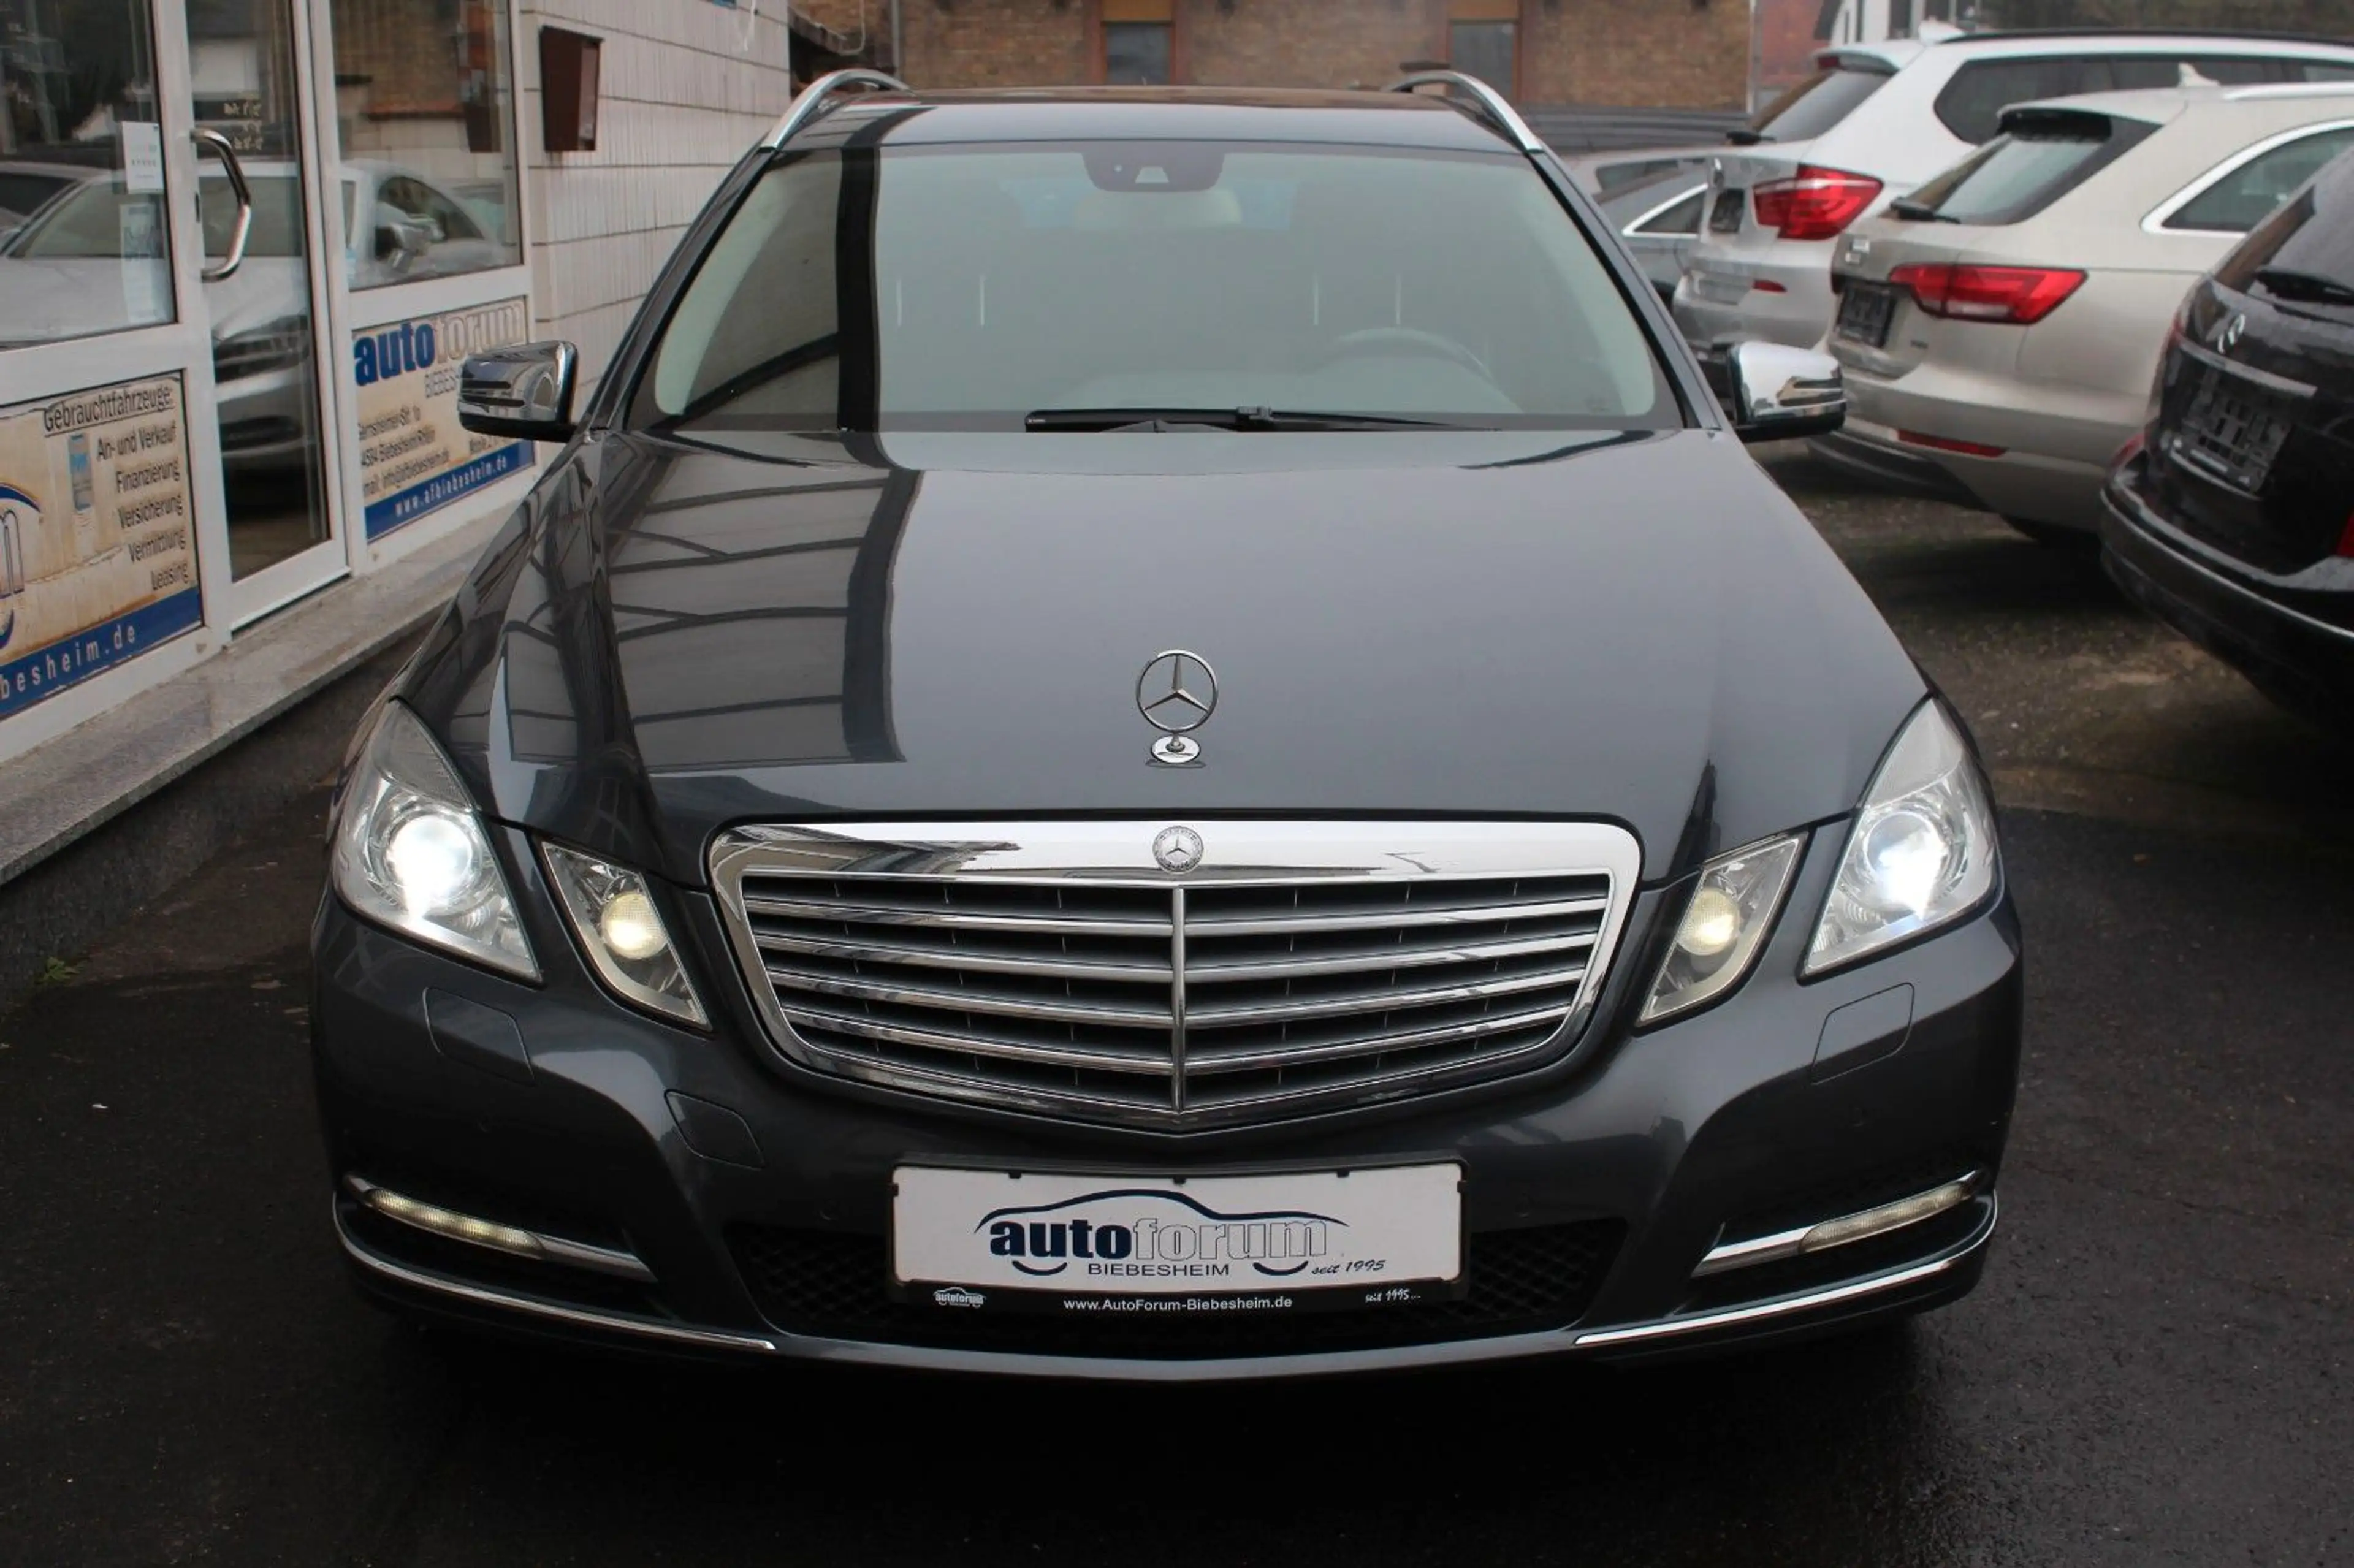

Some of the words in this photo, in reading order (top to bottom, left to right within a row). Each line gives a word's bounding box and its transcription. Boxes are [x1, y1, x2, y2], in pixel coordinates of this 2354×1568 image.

[117, 425, 137, 455] und
[116, 460, 180, 492] Finanzierung
[118, 494, 183, 528] Versicherung
[151, 563, 189, 590] Leasing
[989, 1218, 1326, 1261] autoforum
[1088, 1263, 1229, 1277] BIEBESHEIM
[1311, 1265, 1341, 1275] seit
[1346, 1258, 1387, 1273] 1995
[1064, 1296, 1293, 1312] www.AutoForum-Biebesheim.de
[1365, 1292, 1382, 1303] seit
